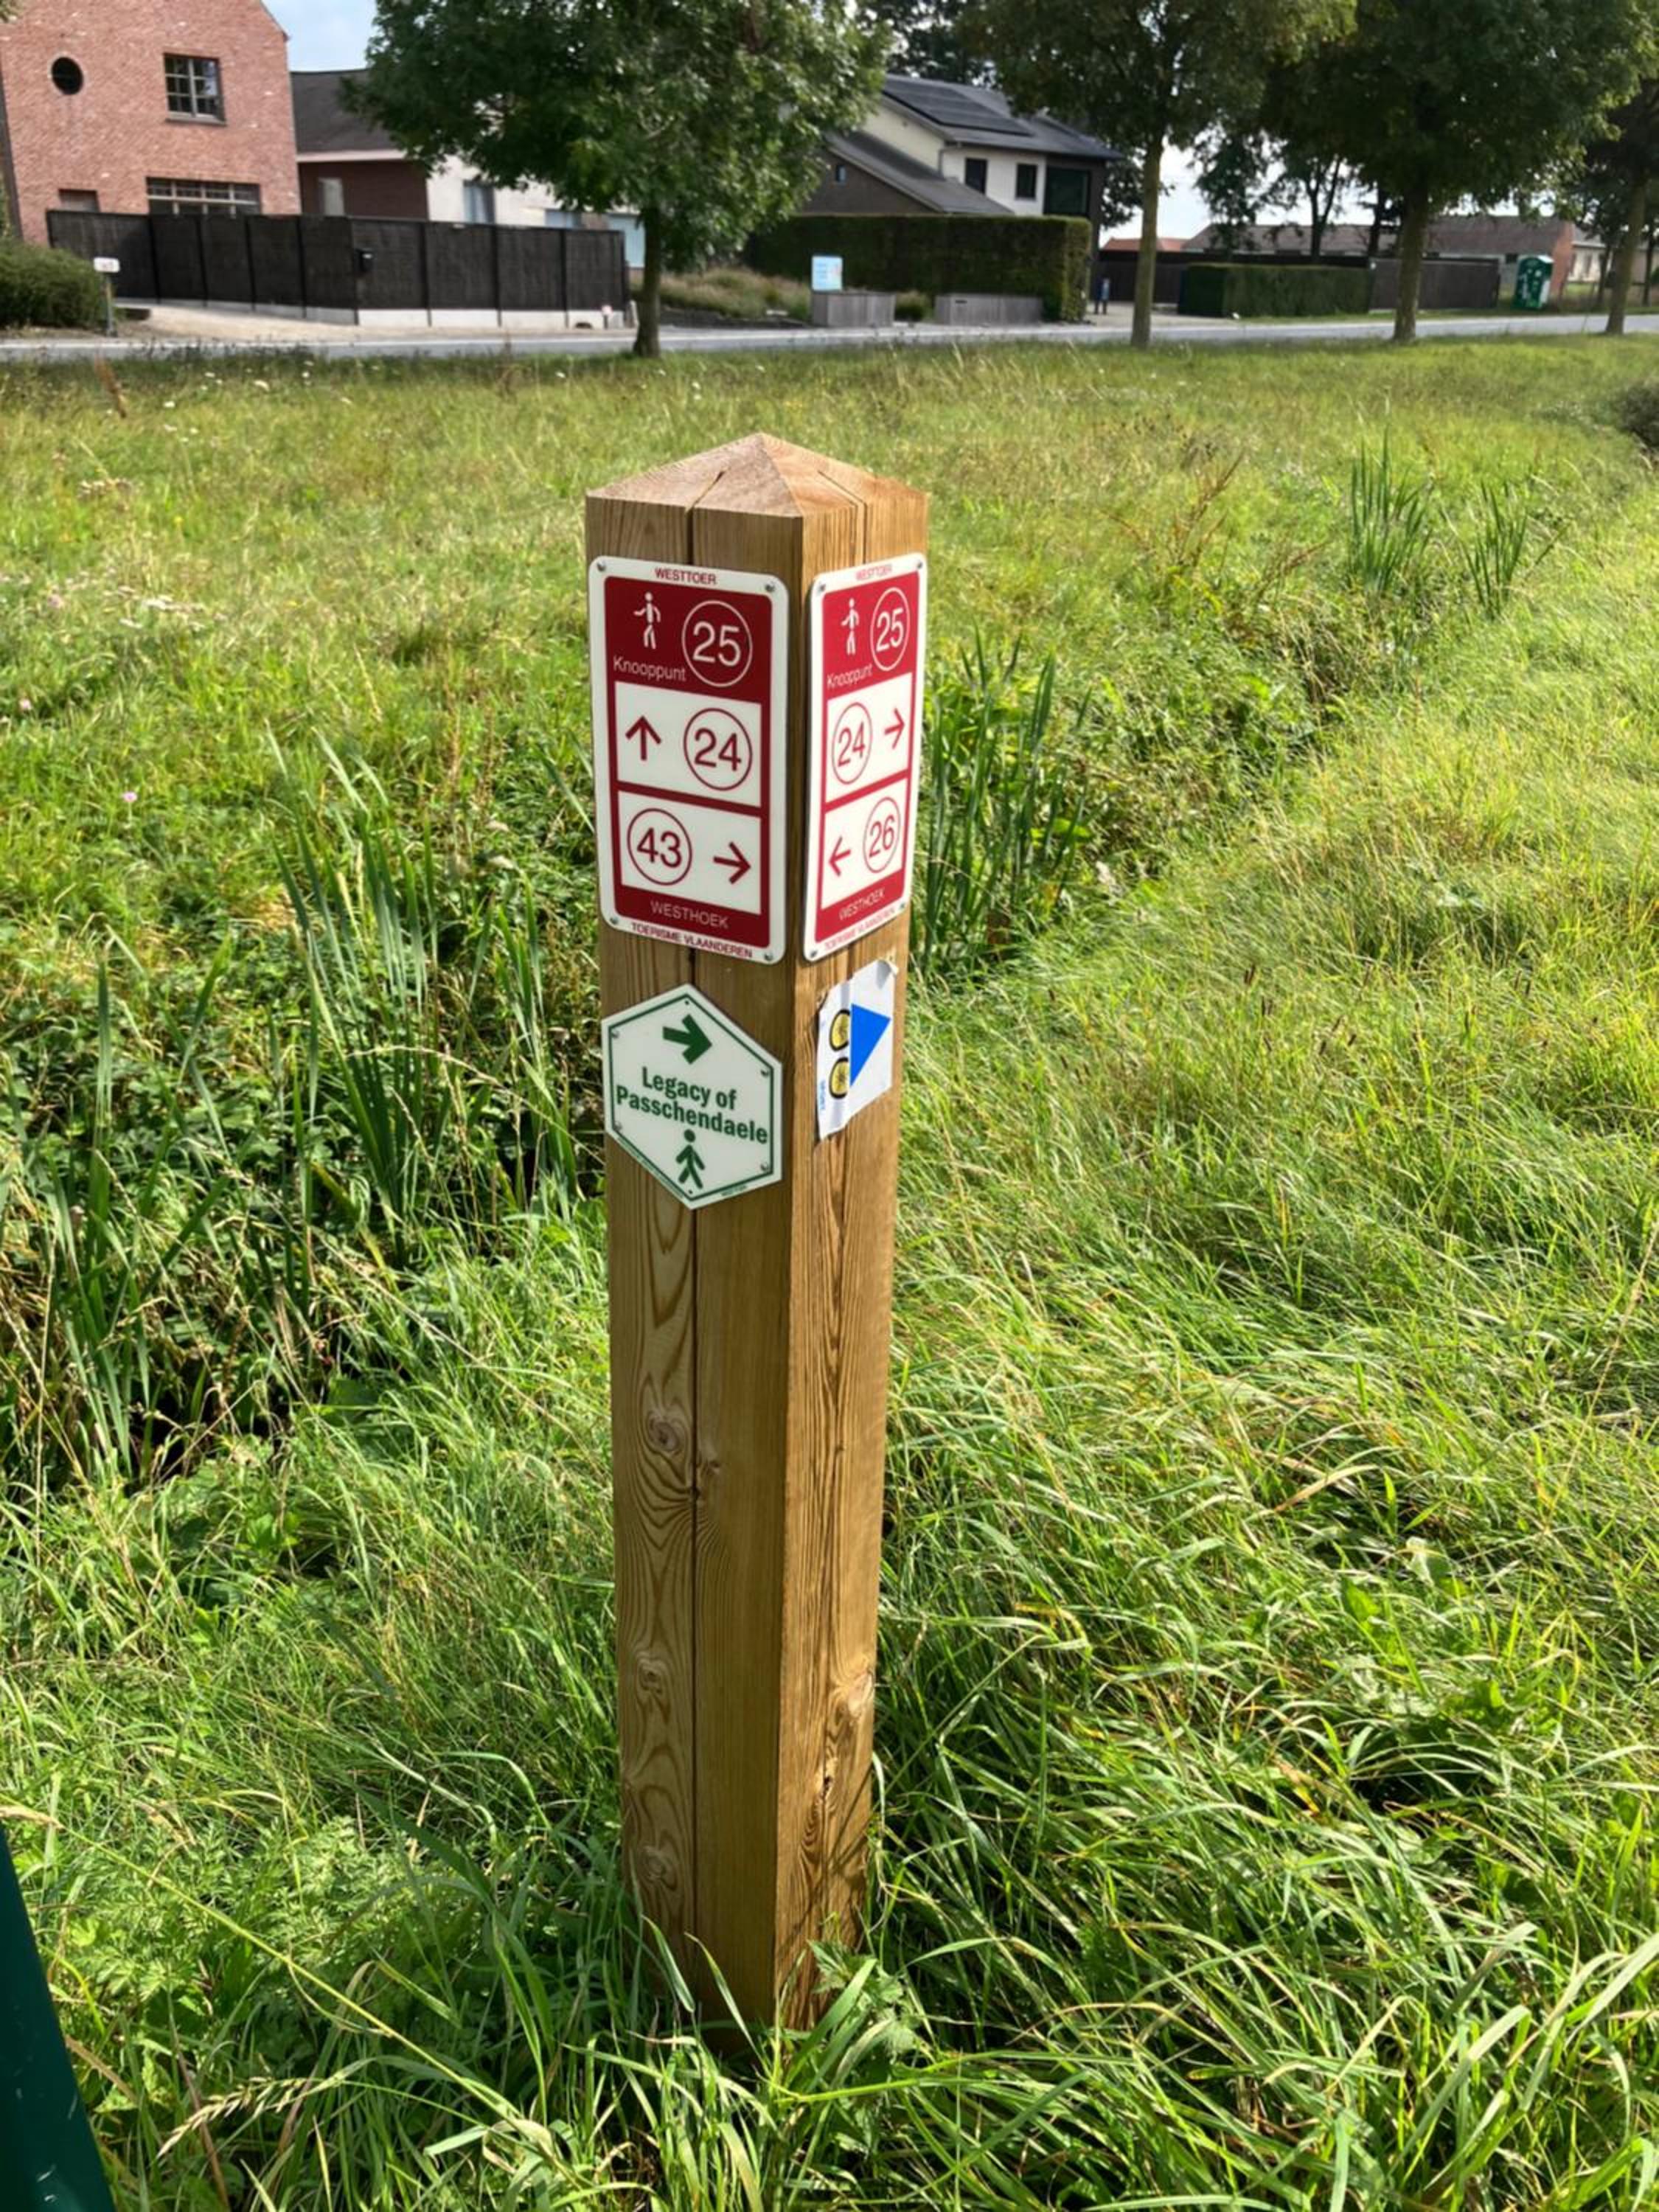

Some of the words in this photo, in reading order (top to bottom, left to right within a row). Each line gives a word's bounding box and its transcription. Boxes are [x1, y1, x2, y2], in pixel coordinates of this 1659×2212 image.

[654, 567, 717, 585] WESTTOER
[692, 621, 741, 667] 25
[875, 607, 904, 653] 25
[613, 655, 687, 682] Knooppunt
[827, 663, 874, 690] Knooppunt
[694, 726, 742, 772] 24
[837, 720, 866, 768] 24
[636, 827, 683, 869] 43
[869, 813, 896, 858] 26
[650, 899, 729, 930] WESTHOEK
[838, 888, 886, 921] WESTHOEK
[630, 922, 683, 944] TOERISME
[684, 936, 753, 959] VLAANDEREN
[641, 1065, 712, 1107] Legacy
[715, 1088, 737, 1110] of
[615, 1084, 768, 1144] Passchendaele
